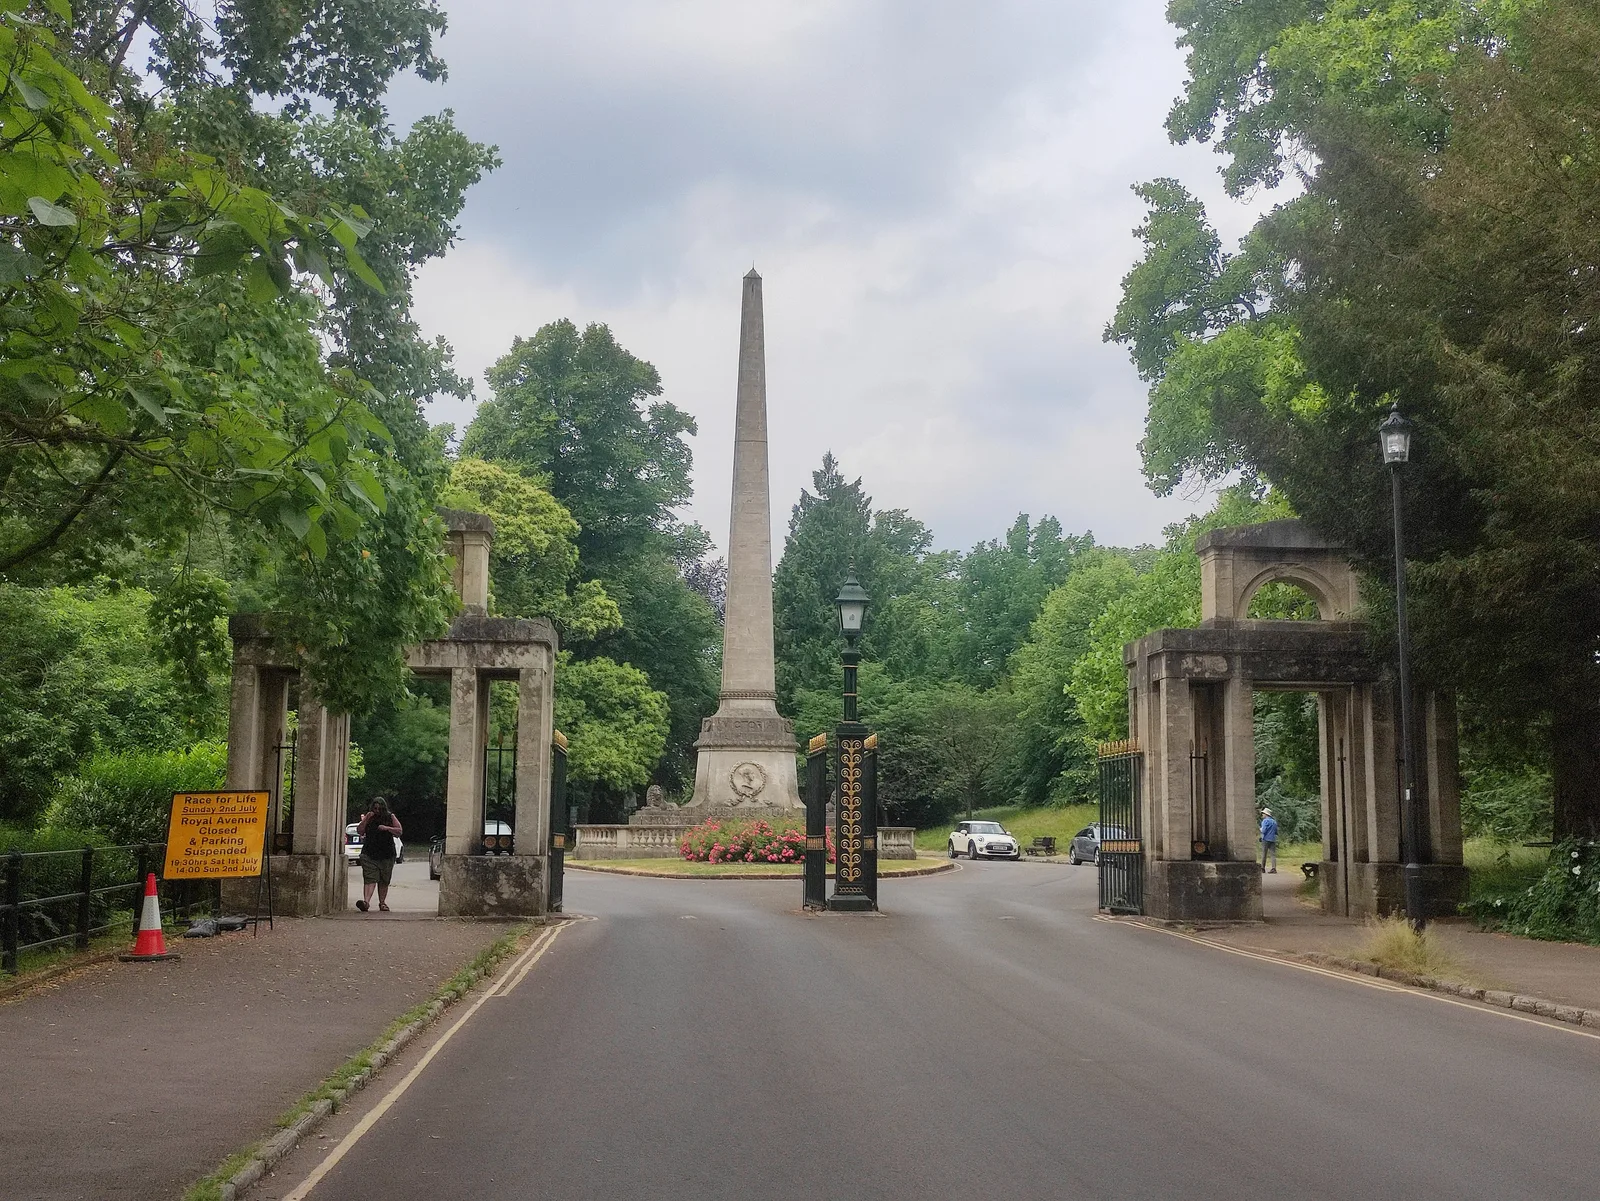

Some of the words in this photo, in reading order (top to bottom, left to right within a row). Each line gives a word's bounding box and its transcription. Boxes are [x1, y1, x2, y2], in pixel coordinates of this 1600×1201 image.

[181, 817, 212, 826] Royal
[202, 837, 244, 845] Parking
[184, 847, 247, 856] Suspended
